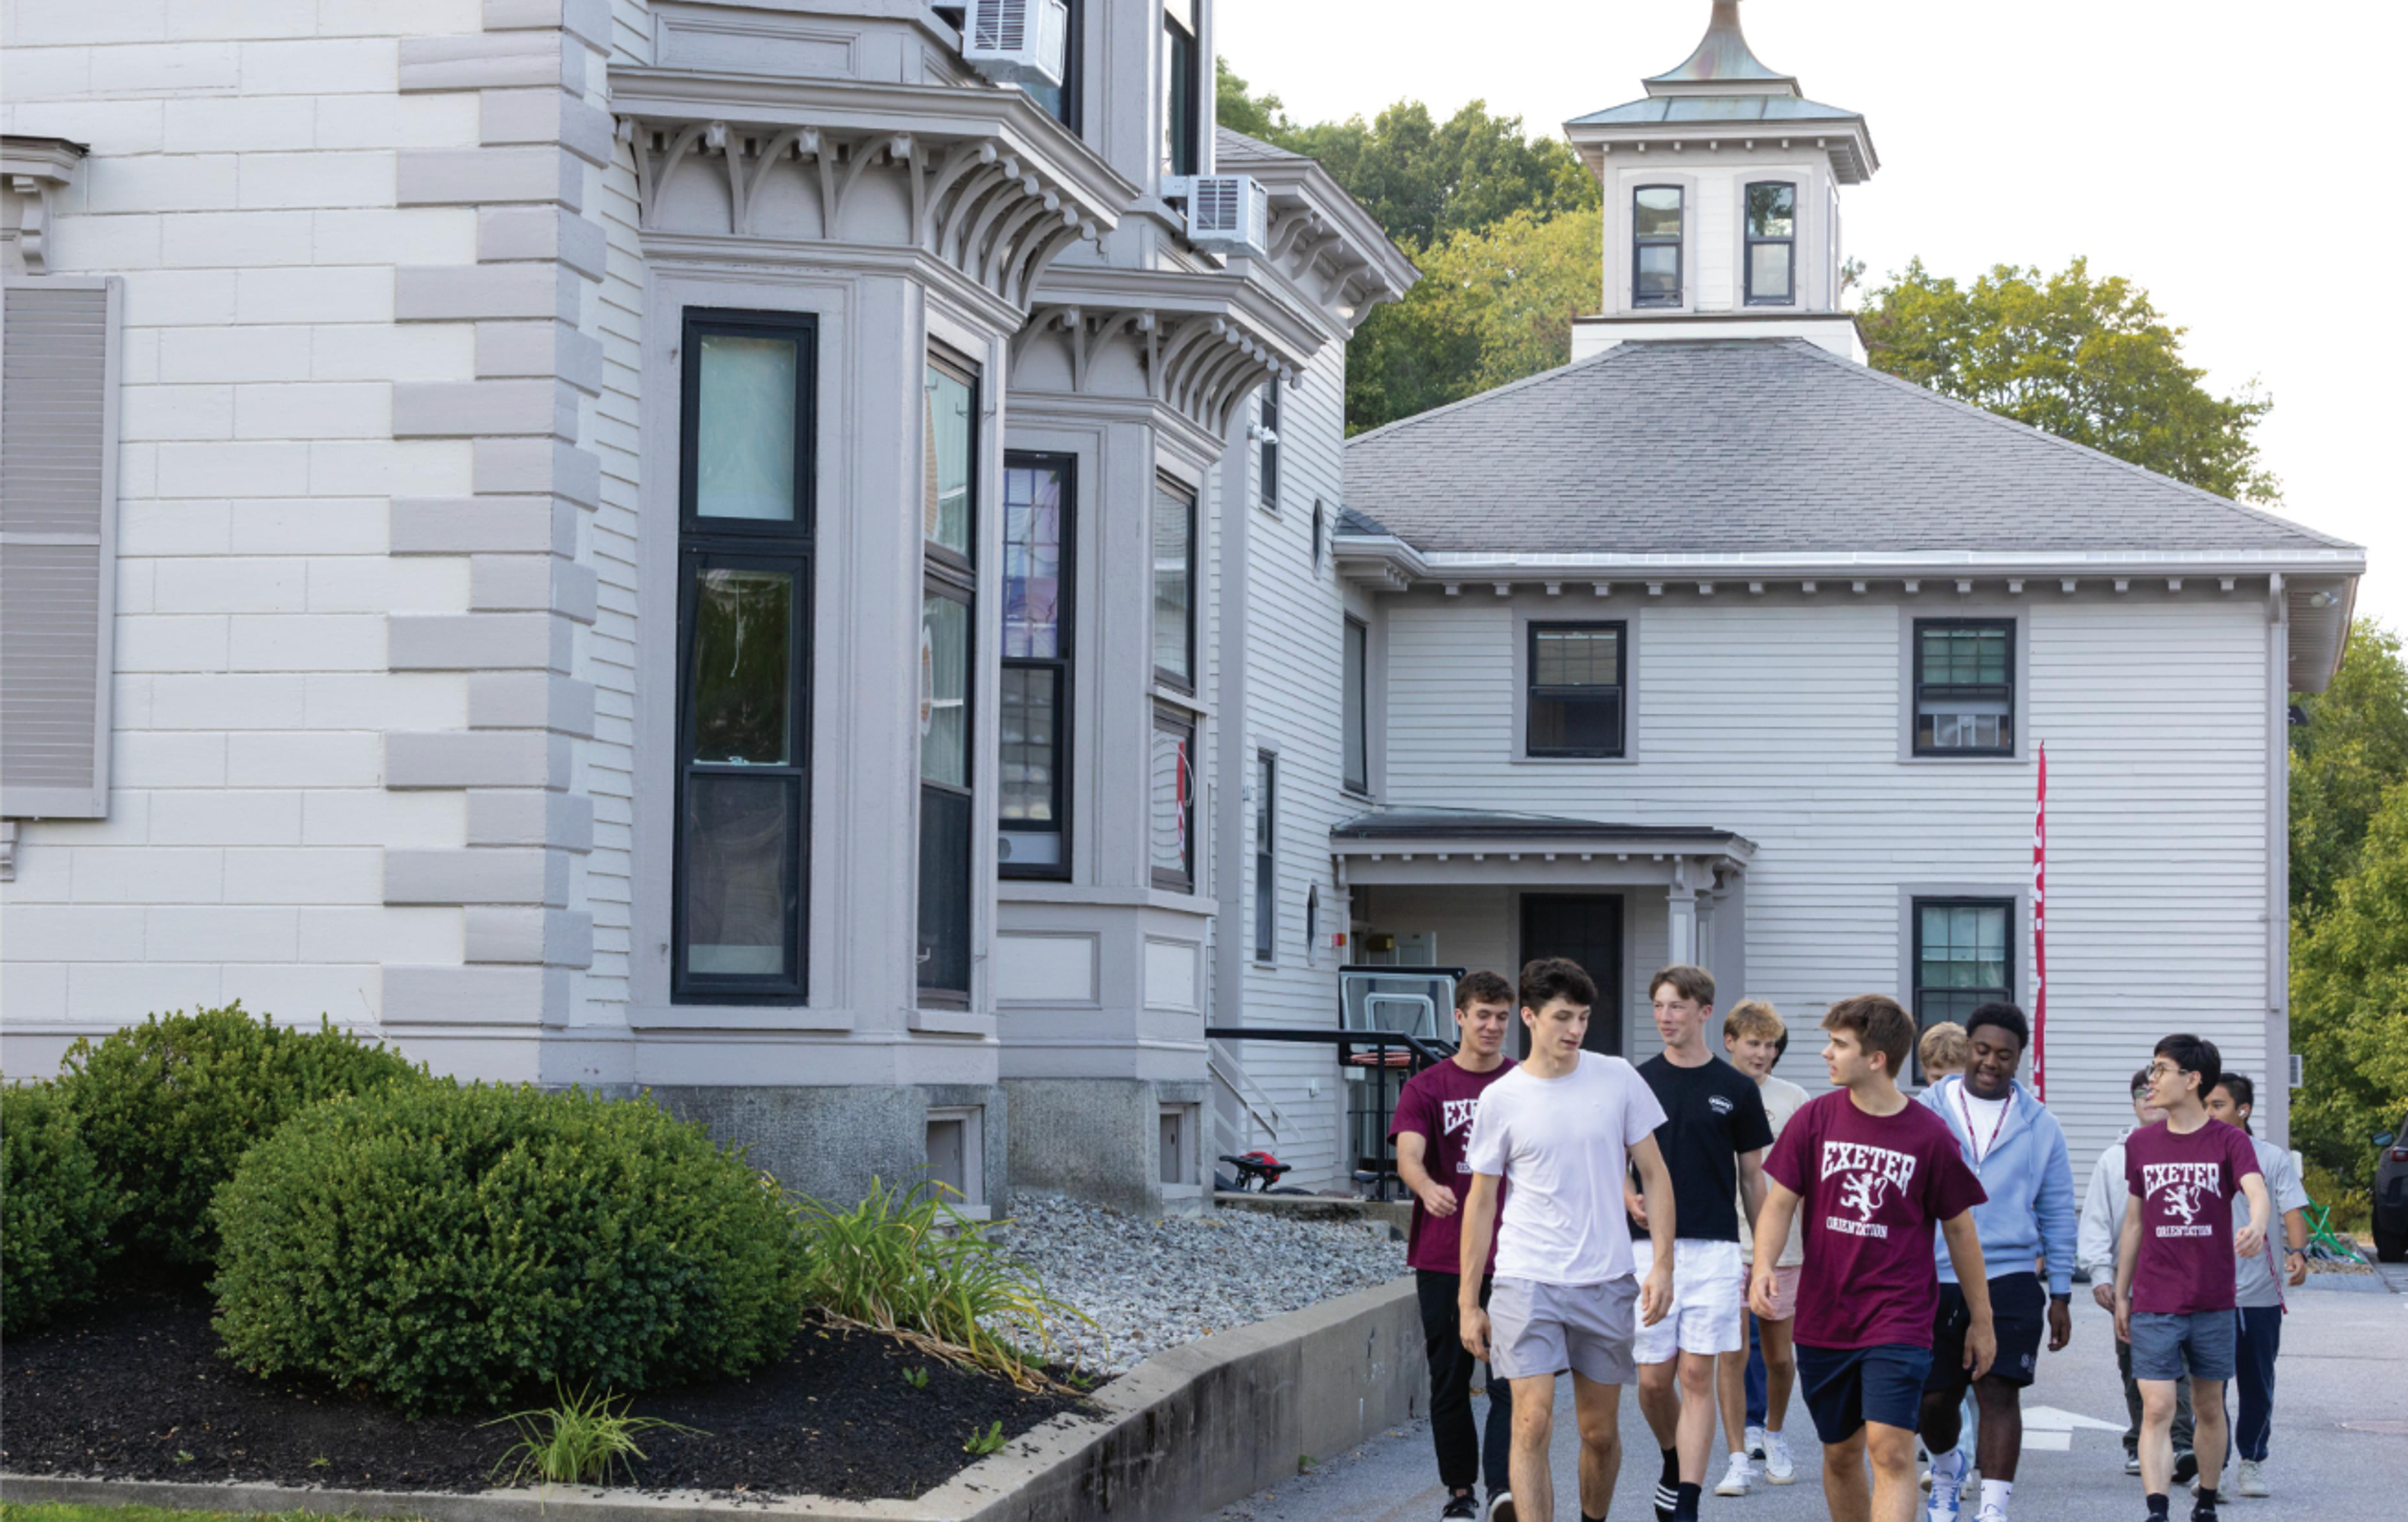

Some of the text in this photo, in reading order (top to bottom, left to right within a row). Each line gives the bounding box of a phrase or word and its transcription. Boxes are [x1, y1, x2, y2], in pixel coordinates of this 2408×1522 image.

[1821, 1140, 1916, 1198] EXETER
[2143, 1162, 2222, 1200] EXETER
[1826, 1216, 1888, 1239] ORIENTATION
[2156, 1225, 2212, 1237] ORIENTATION
